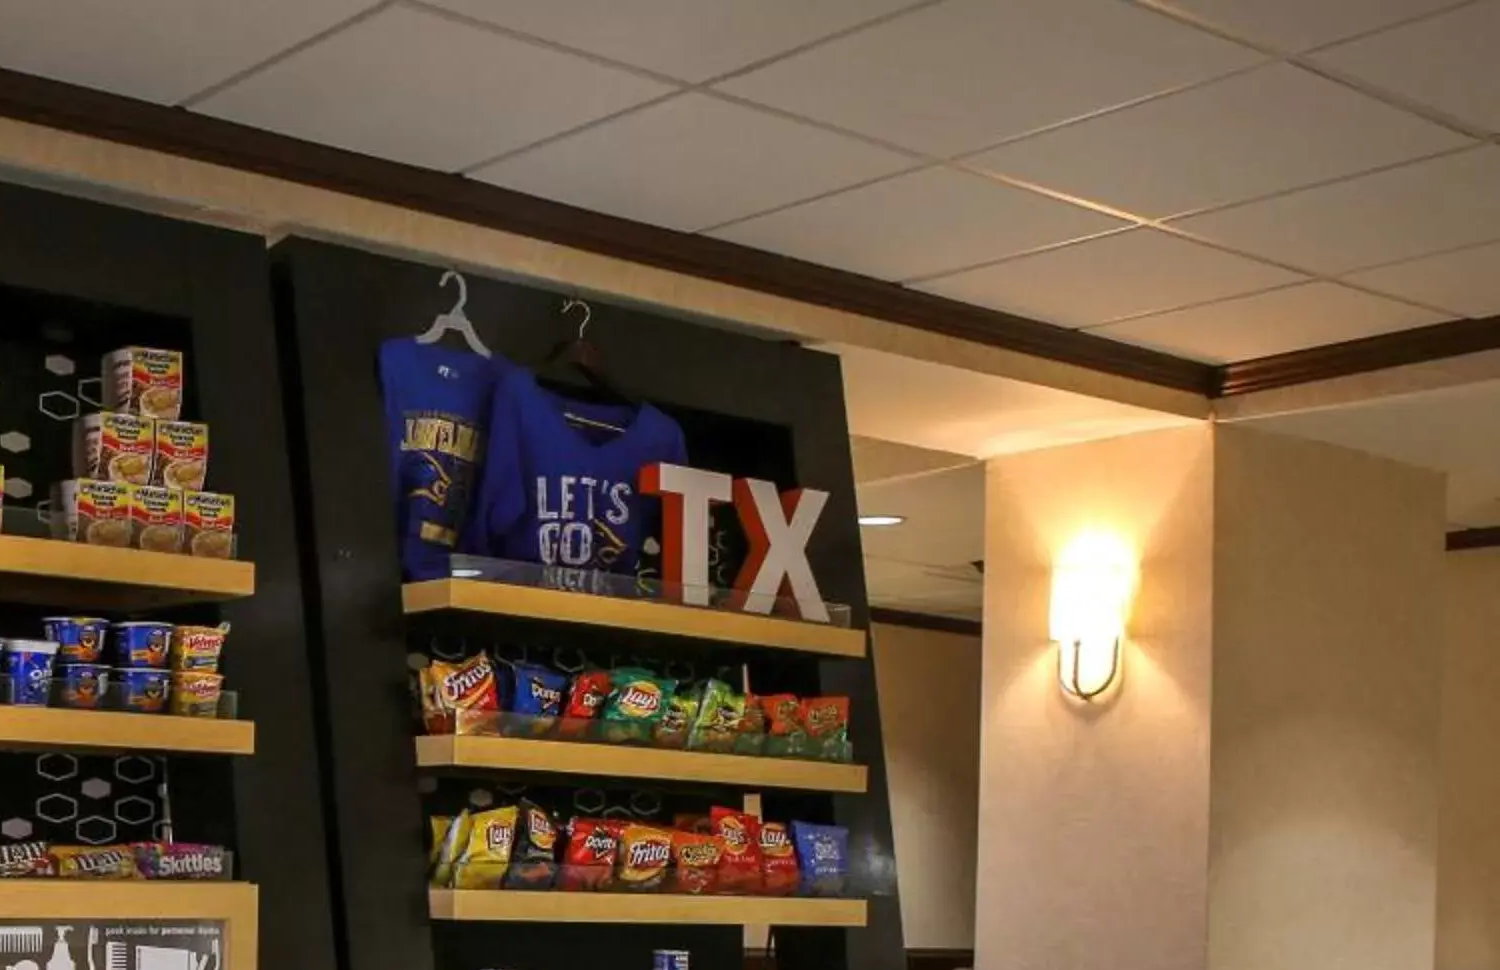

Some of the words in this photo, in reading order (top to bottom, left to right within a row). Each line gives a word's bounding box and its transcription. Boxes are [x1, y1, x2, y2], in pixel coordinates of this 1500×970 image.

[537, 475, 632, 525] LET'S
[539, 521, 593, 566] GO
[640, 461, 830, 624] TX
[158, 853, 222, 876] Skittles
[630, 841, 670, 864] Fritos
